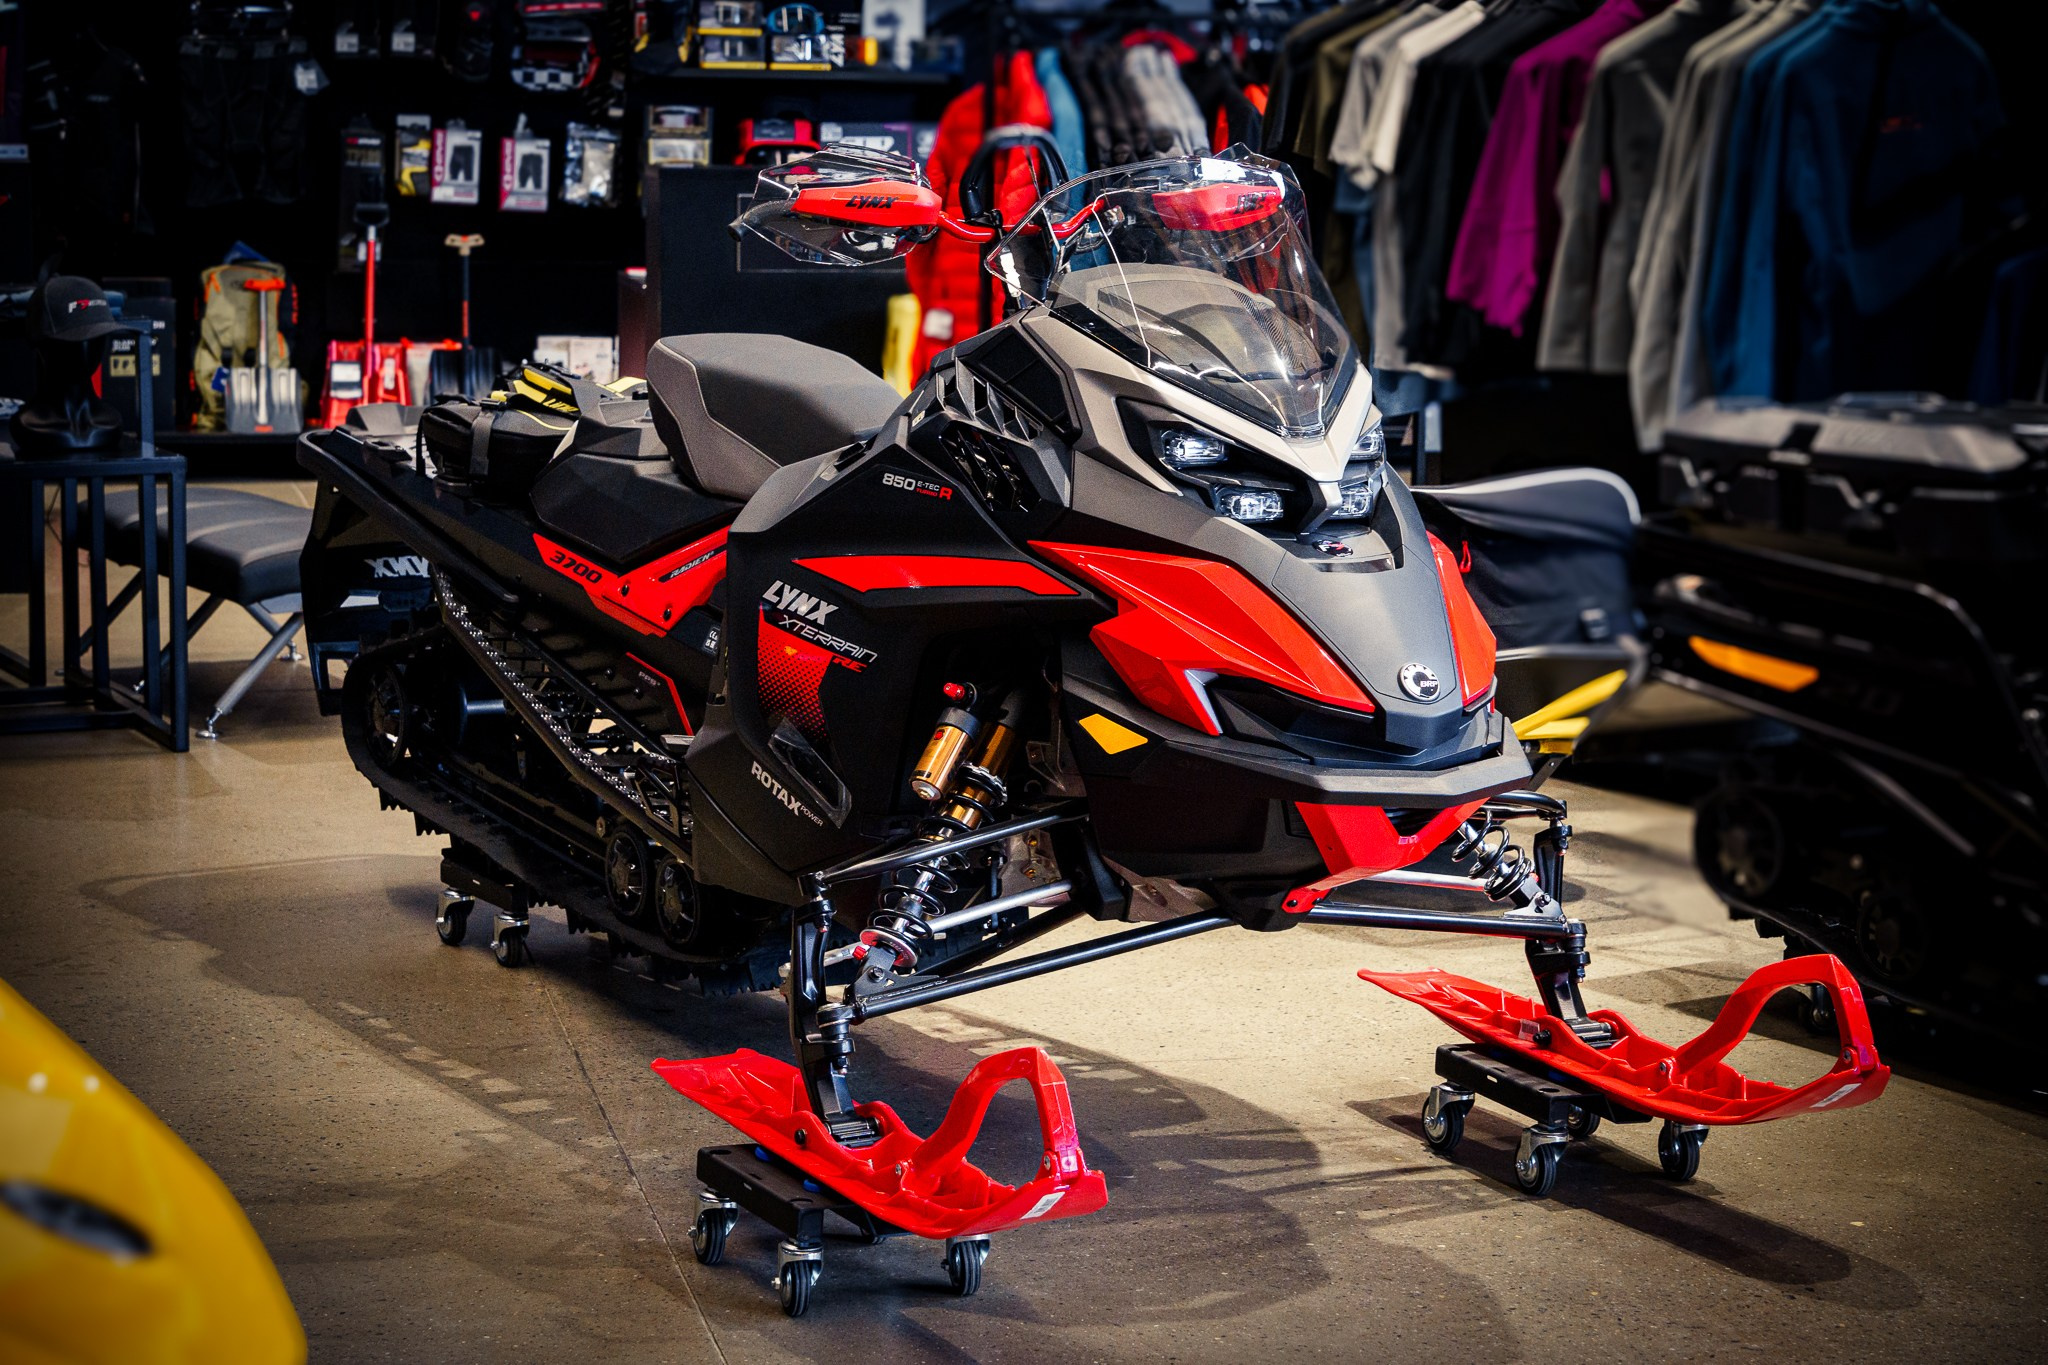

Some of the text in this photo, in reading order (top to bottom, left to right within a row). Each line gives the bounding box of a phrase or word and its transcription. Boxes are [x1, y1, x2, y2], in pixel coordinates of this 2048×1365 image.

[845, 195, 899, 209] LYNX
[882, 472, 916, 491] 850
[939, 486, 953, 500] R
[550, 551, 602, 583] 3700
[762, 579, 839, 625] LYNX
[778, 614, 878, 663] XTERRAIN
[751, 760, 801, 816] ROTAX
